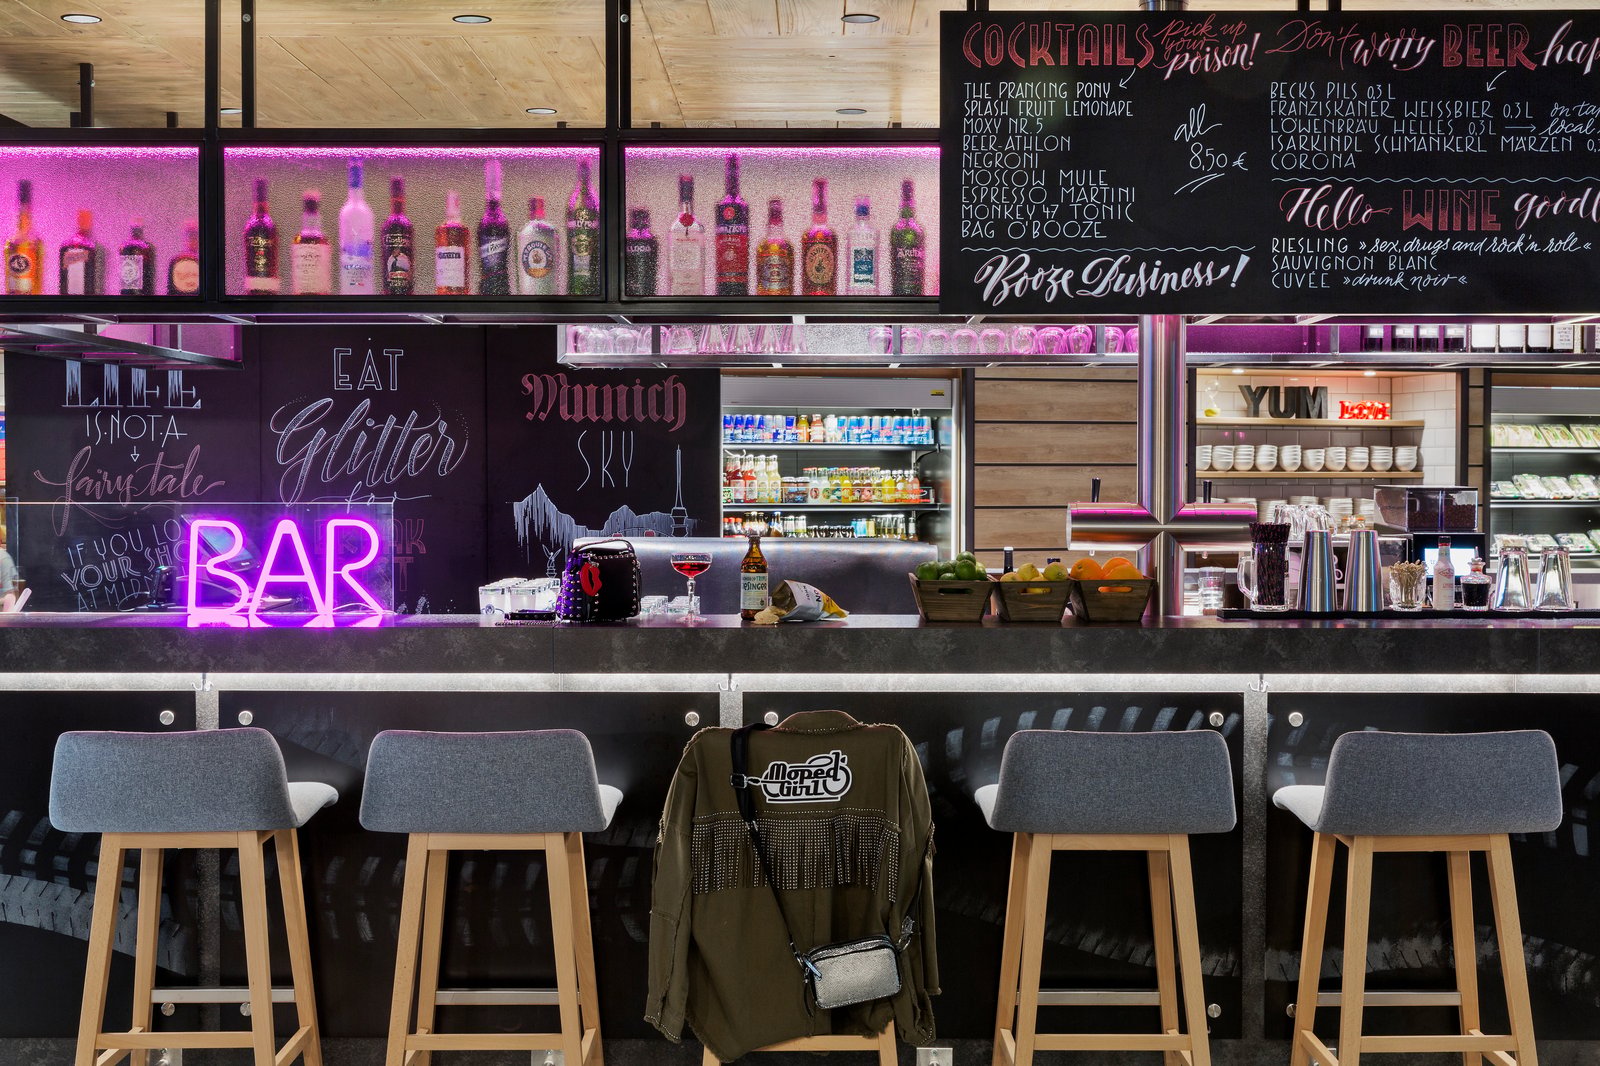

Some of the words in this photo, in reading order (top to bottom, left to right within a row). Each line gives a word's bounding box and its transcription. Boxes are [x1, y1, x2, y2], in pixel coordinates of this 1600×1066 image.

[1153, 13, 1218, 44] pick
[1219, 20, 1247, 44] up
[962, 21, 1154, 69] COCKTAILS
[1164, 36, 1219, 61] your
[1265, 19, 1360, 71] Don't
[1350, 28, 1436, 71] worry
[1442, 23, 1538, 71] BEER
[1153, 32, 1261, 80] poison!
[963, 82, 991, 99] THE
[999, 81, 1068, 99] PRANCING
[1076, 82, 1111, 99] PONY
[1270, 81, 1315, 100] BECKS
[1326, 82, 1358, 100] PILS
[1388, 83, 1396, 100] L
[964, 100, 1009, 117] SPLASH
[1018, 100, 1056, 117] FRUIT
[1065, 100, 1133, 117] LEMONADE
[1270, 100, 1395, 118] FRANZISKANER
[1404, 100, 1494, 118] WEISSBIER
[1525, 101, 1534, 118] L
[1550, 102, 1571, 117] on
[963, 118, 1001, 134] MOXY
[1174, 102, 1222, 142] all
[1270, 117, 1378, 134] LÖWENBRÄU
[1393, 119, 1454, 135] HELLES
[1488, 120, 1497, 135] L
[1539, 117, 1596, 136] local
[962, 135, 1071, 152] BEER-ATHLON
[1270, 134, 1363, 152] ISARKINDL
[1374, 133, 1488, 154] SCHMANKERL
[1500, 135, 1572, 152] MÄRZEN
[961, 152, 1039, 169] NEGRONI
[1189, 142, 1227, 171] 8,50
[1232, 151, 1249, 171] €
[1270, 152, 1356, 170] CORONA
[961, 169, 1046, 186] MOSCOW
[1059, 169, 1108, 186] MULE
[961, 186, 1047, 204] ESPRESSO
[1061, 187, 1136, 203] MARTINI
[961, 204, 1035, 220] MONKEY
[1042, 204, 1059, 220] 47
[1069, 204, 1134, 222] TONIC
[1279, 184, 1393, 231] Hello
[1402, 189, 1502, 231] WINE
[961, 221, 995, 239] BAG
[1271, 237, 1348, 253] RIESLING
[1402, 236, 1451, 255] drugs
[1452, 236, 1488, 256] and
[1271, 255, 1375, 272] SAUVIGNON
[1388, 254, 1438, 271] BLANC
[974, 253, 1074, 307] Booze
[1076, 253, 1250, 298] Business!
[1271, 271, 1330, 289] CUVÉE
[333, 347, 404, 391] EAT
[521, 372, 687, 432] Munich
[1238, 384, 1329, 419] YUM
[1338, 400, 1391, 420] LOVE
[270, 394, 468, 508] Glitter
[576, 430, 634, 491] SKY
[33, 444, 138, 537] fairy
[133, 444, 226, 498] tale
[67, 542, 85, 569] IF
[93, 528, 144, 560] YOU
[152, 518, 181, 546] LO
[60, 556, 141, 592] YOUR
[187, 519, 385, 614] BAR
[78, 587, 99, 612] AT
[769, 751, 841, 785] Moped
[779, 779, 825, 797] Girl
